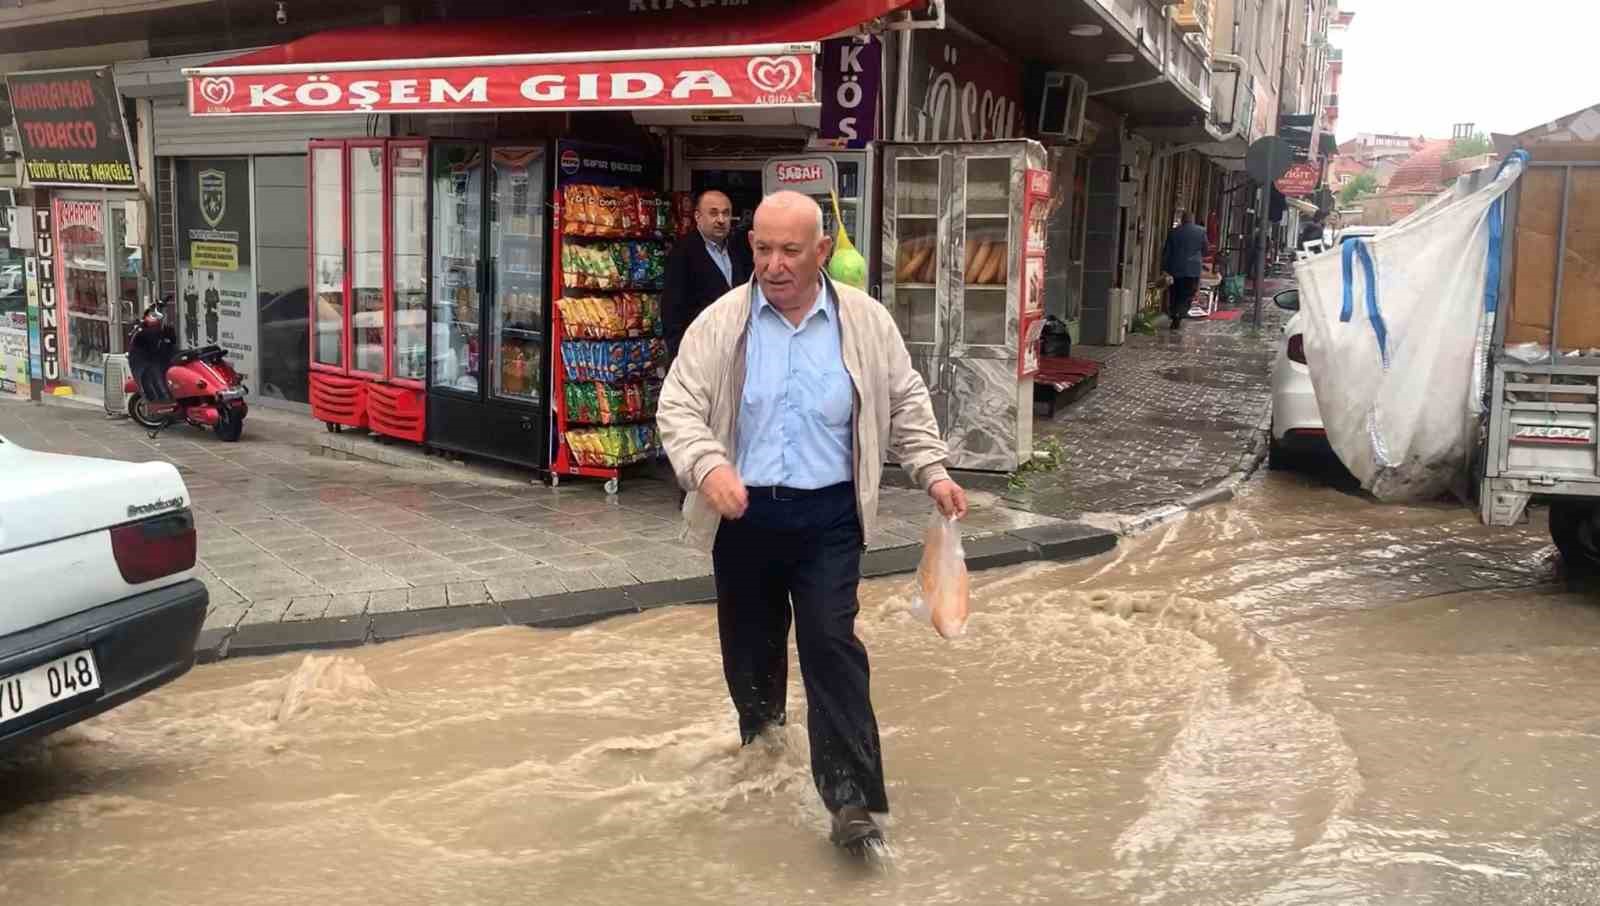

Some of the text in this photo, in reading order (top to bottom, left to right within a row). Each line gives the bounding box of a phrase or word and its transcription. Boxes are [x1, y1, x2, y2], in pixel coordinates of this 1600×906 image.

[250, 69, 733, 112] KÖŞEM GIDA
[23, 121, 97, 149] TOBACCO
[28, 160, 58, 179] TÜTÜN
[37, 211, 58, 380] TÜTÜNCÜ
[47, 656, 92, 697] 048
